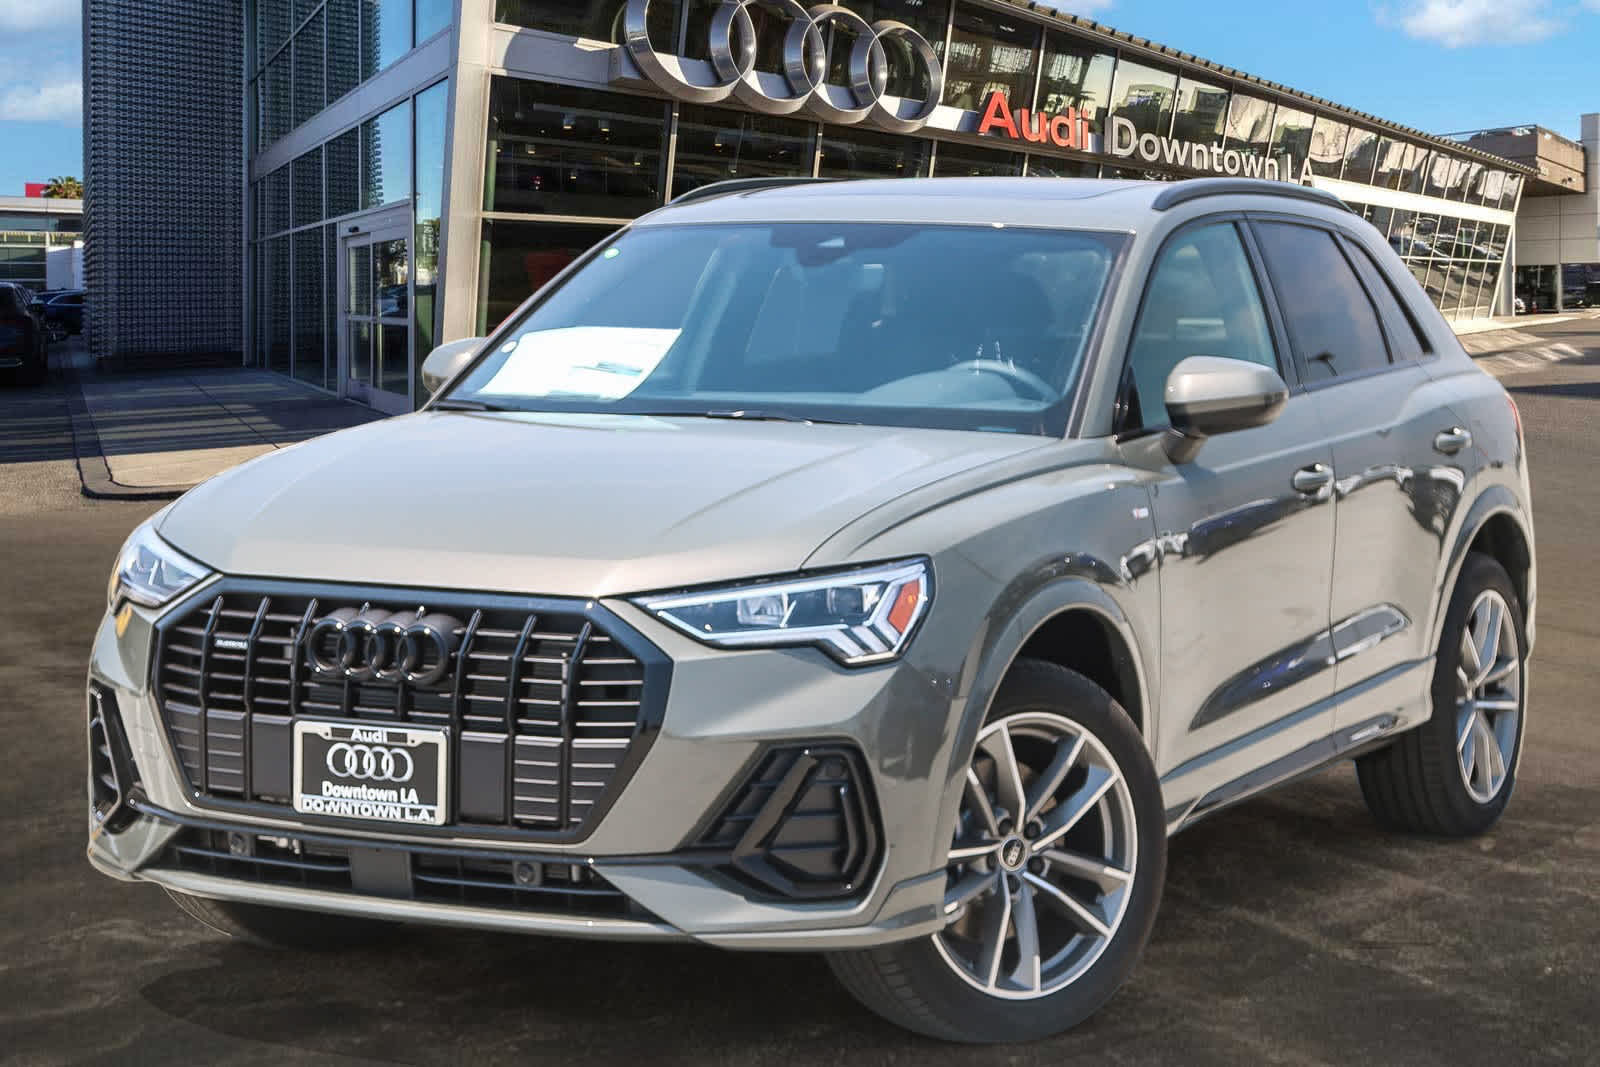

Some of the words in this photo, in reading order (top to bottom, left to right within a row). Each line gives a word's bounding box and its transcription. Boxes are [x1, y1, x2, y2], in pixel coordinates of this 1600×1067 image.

[978, 91, 1089, 151] Audi
[1107, 115, 1279, 181] Downtown
[1287, 153, 1315, 187] LA
[350, 728, 388, 744] Audi
[321, 780, 398, 803] Downtown
[400, 787, 419, 804] LA
[303, 799, 401, 820] DOWNTOWN
